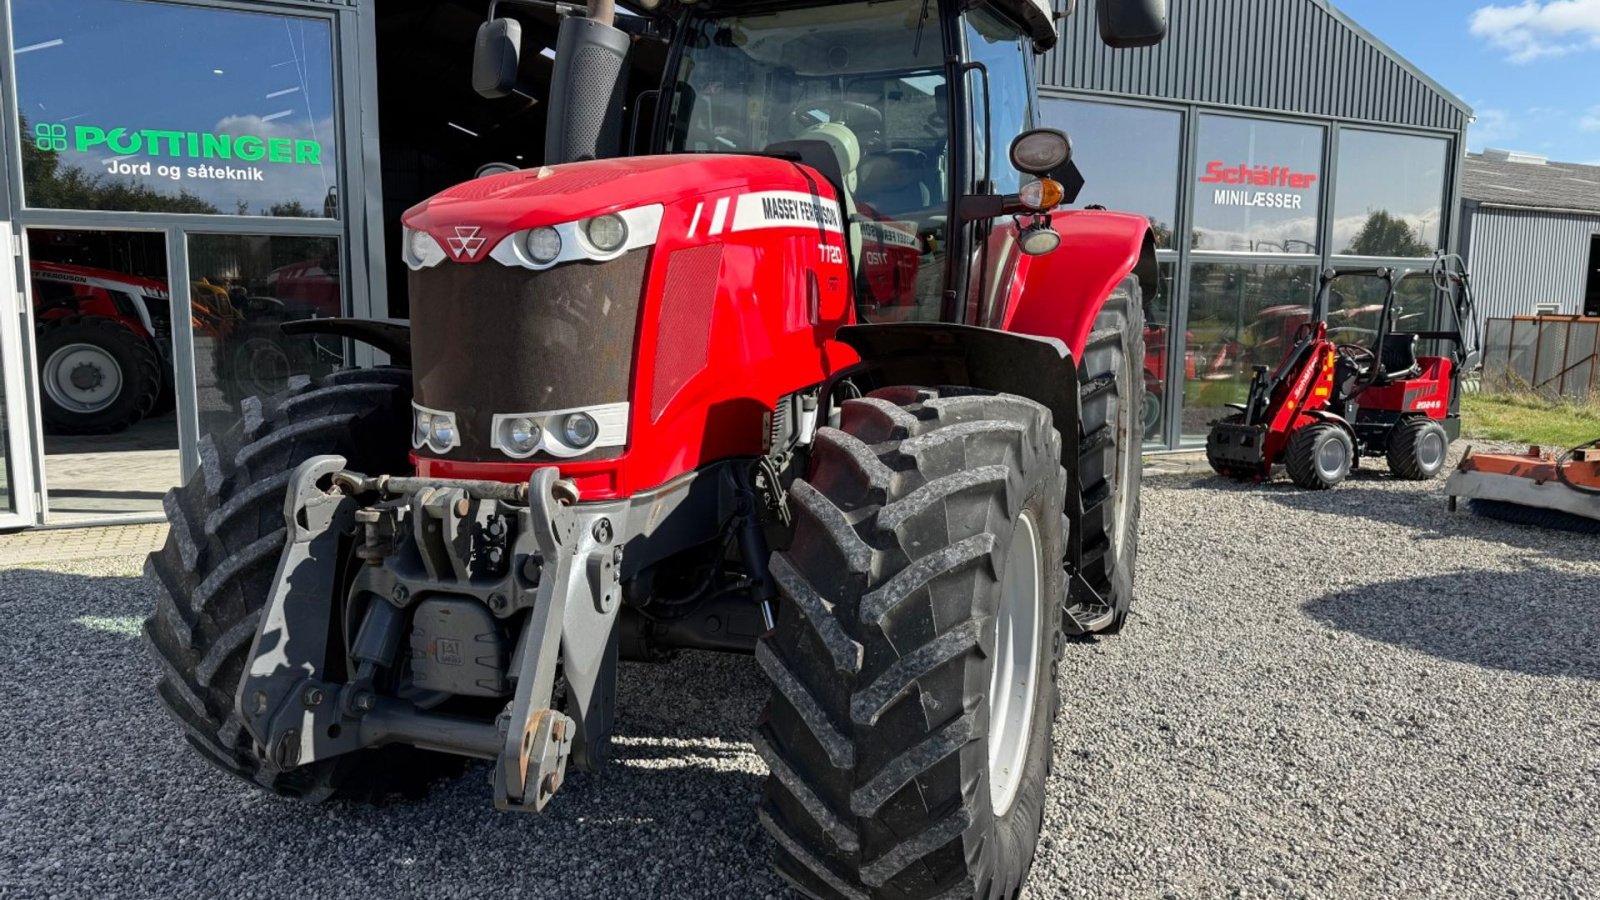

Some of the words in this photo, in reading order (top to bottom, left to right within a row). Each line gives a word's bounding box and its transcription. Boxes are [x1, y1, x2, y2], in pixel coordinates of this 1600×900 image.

[108, 160, 151, 176] Jord
[157, 165, 181, 180] og
[187, 164, 264, 181] såteknik
[1199, 161, 1317, 188] Schäffer
[1214, 189, 1302, 209] MINILÆSSER
[761, 197, 800, 220] MASSEY
[799, 200, 838, 227] FERGUSON
[818, 244, 843, 264] 7720
